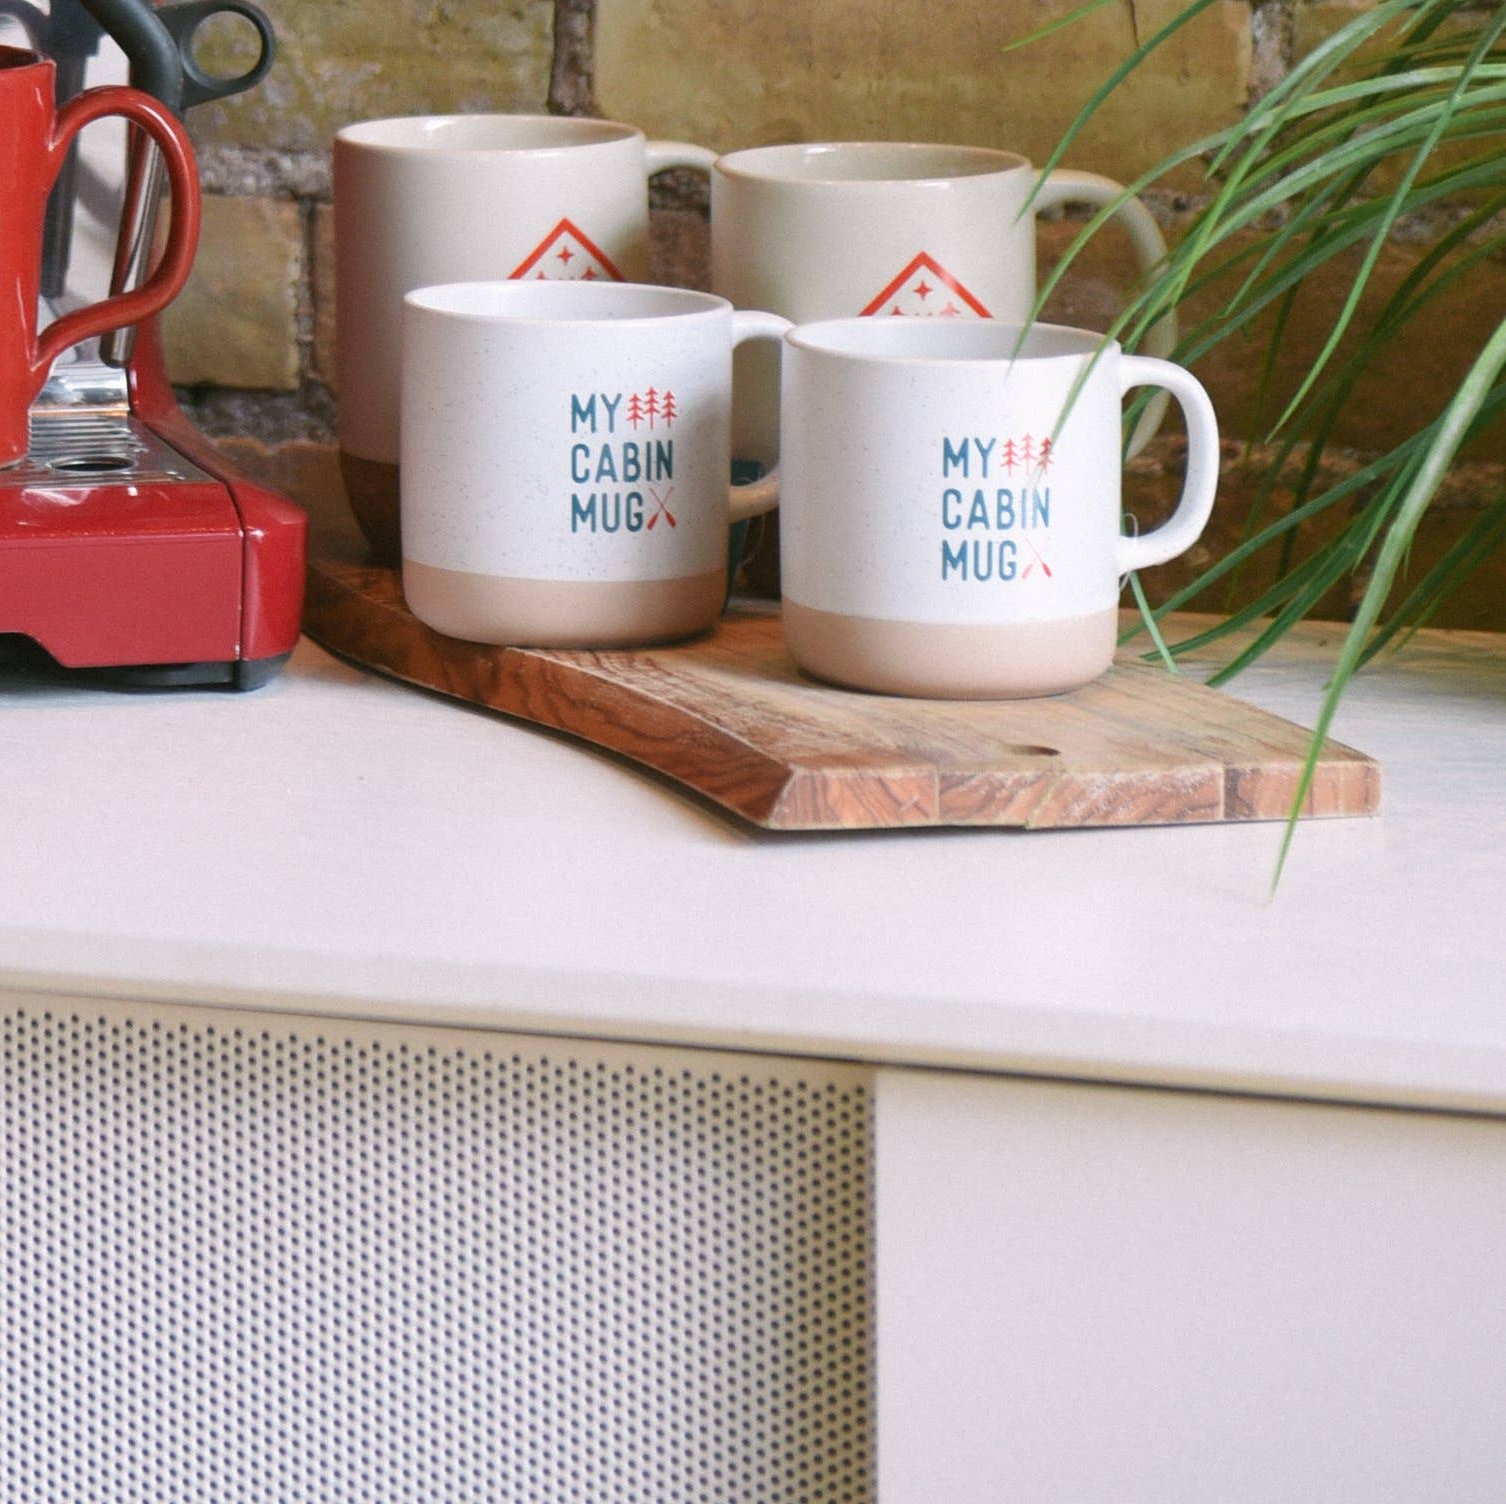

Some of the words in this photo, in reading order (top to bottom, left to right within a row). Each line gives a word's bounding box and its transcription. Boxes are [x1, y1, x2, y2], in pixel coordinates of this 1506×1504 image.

[571, 393, 622, 433] MY
[570, 440, 674, 484] CABIN
[942, 437, 997, 478] MY
[570, 492, 644, 533] MUG
[942, 487, 1050, 530] CABIN
[941, 539, 1017, 581] MUG
